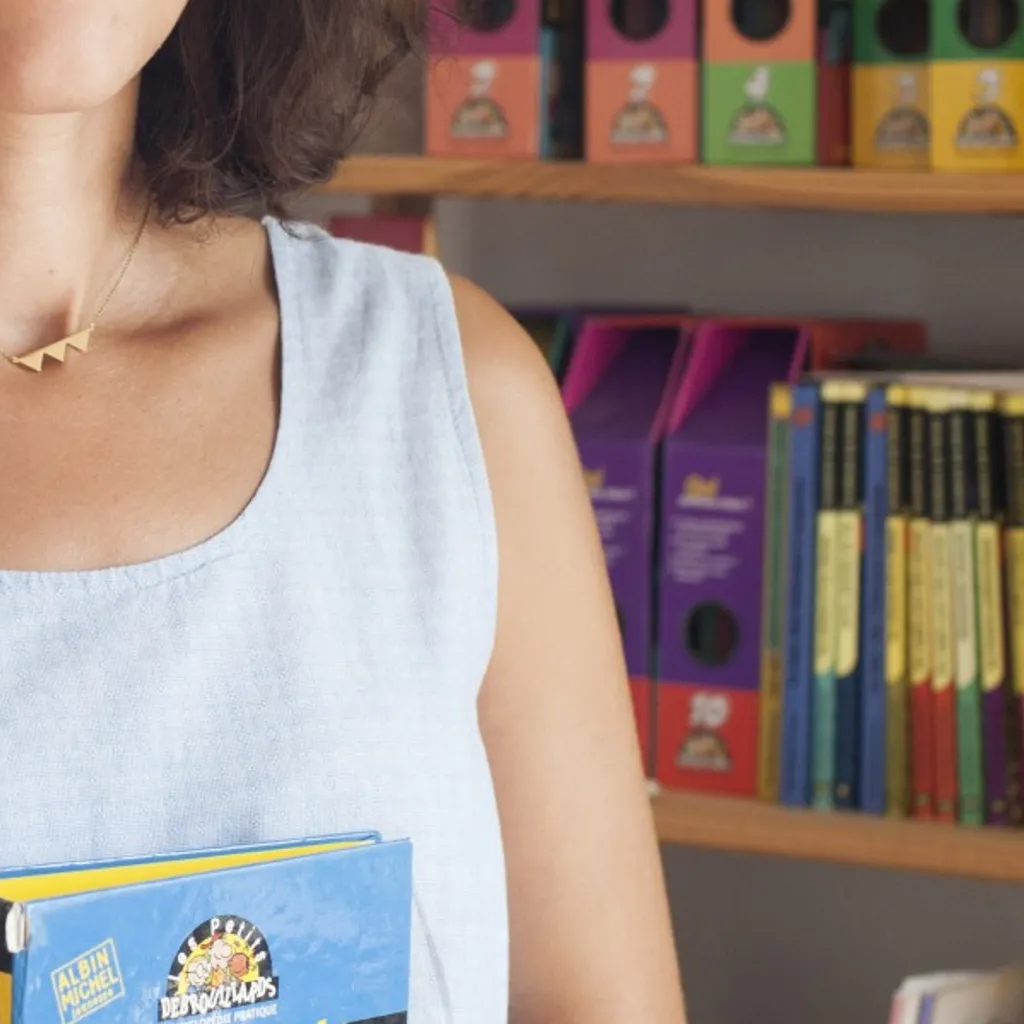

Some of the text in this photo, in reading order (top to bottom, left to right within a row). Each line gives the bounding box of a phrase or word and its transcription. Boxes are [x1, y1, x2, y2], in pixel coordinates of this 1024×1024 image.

[210, 918, 267, 963] Petits
[58, 947, 109, 994] ALBIN
[60, 967, 120, 1012] MICHEL
